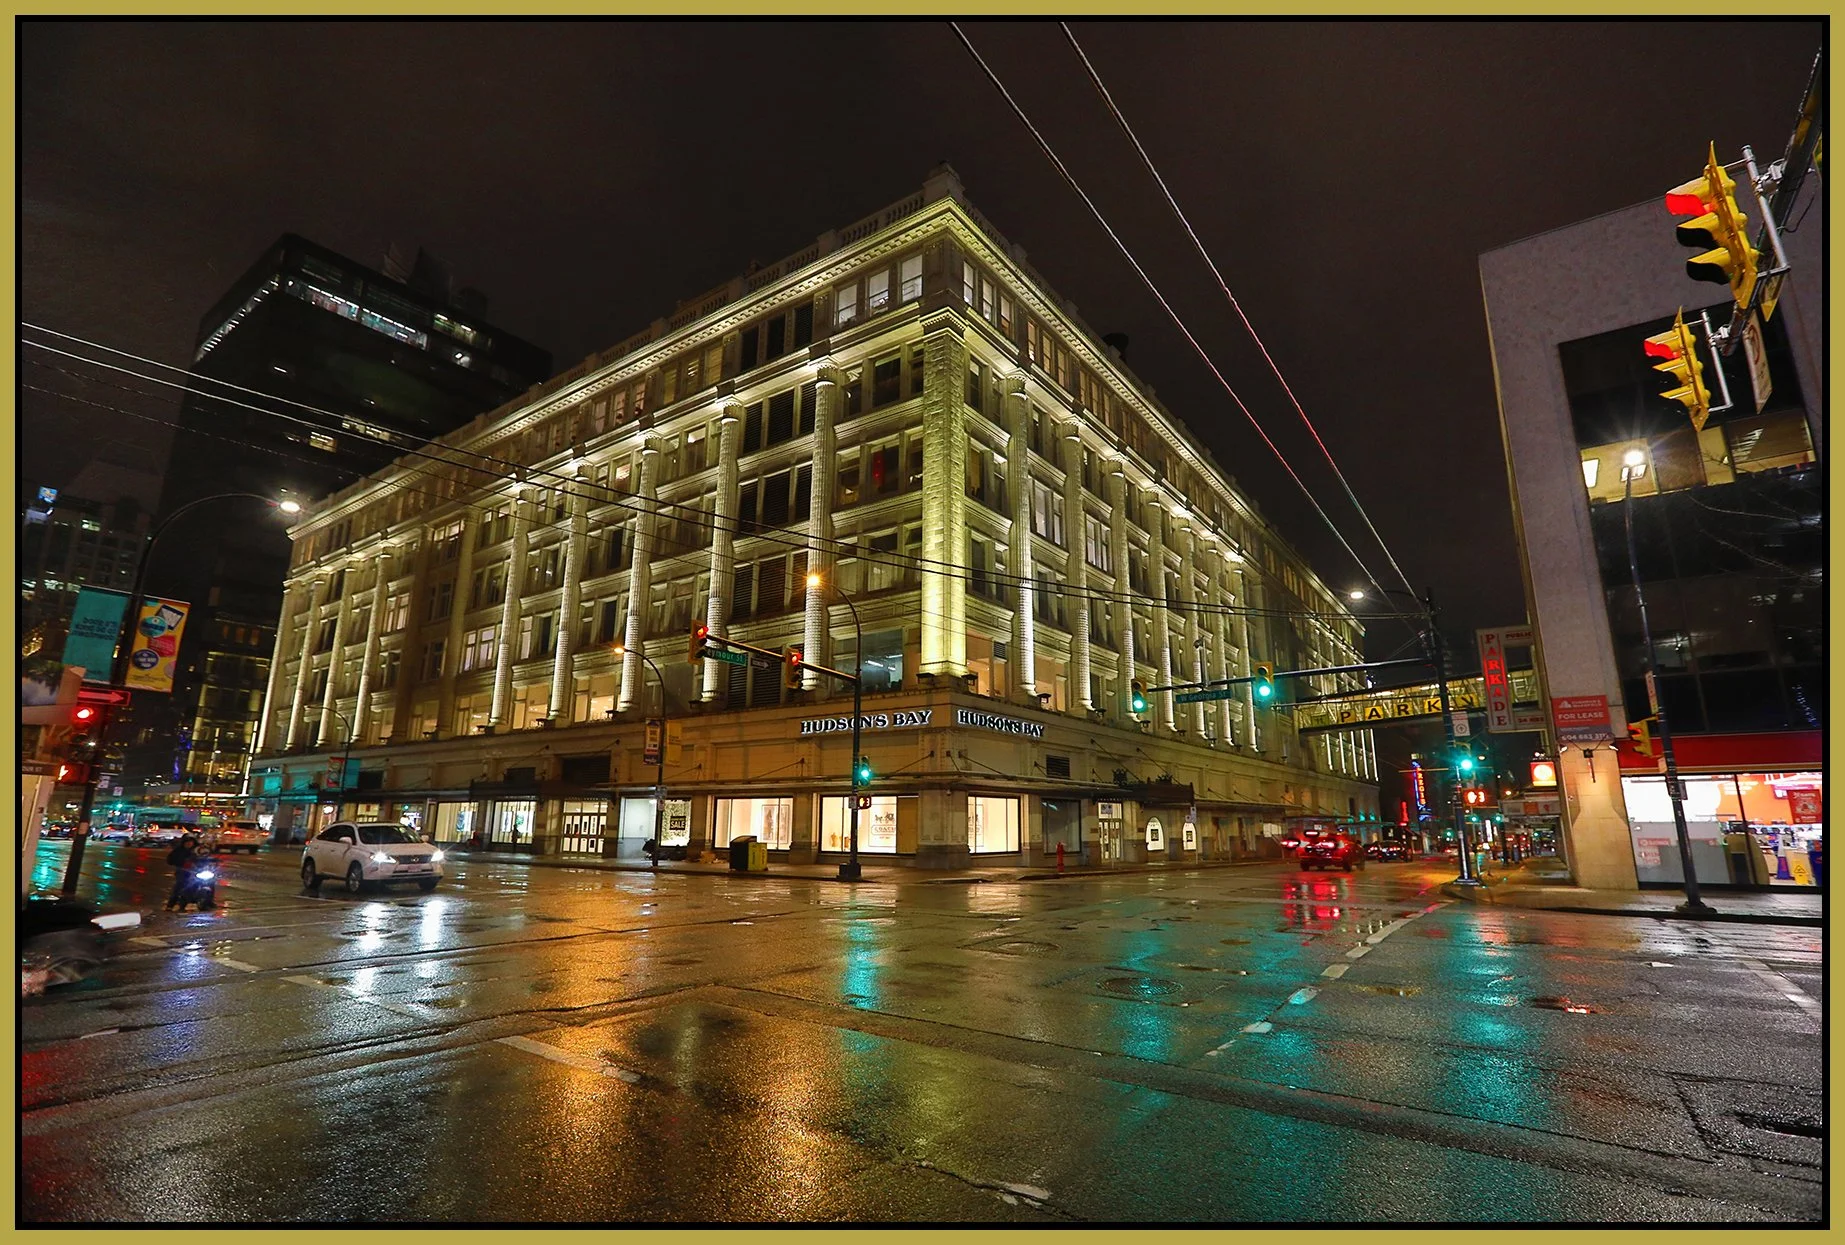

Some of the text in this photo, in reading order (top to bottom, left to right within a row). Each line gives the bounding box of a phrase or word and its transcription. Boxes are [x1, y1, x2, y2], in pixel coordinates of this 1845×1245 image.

[1484, 633, 1508, 727] PARKADE
[800, 709, 933, 735] HUDSON'S BAY
[1577, 711, 1605, 719] LEASE
[1022, 720, 1045, 738] BAY
[670, 820, 685, 829] SALE
